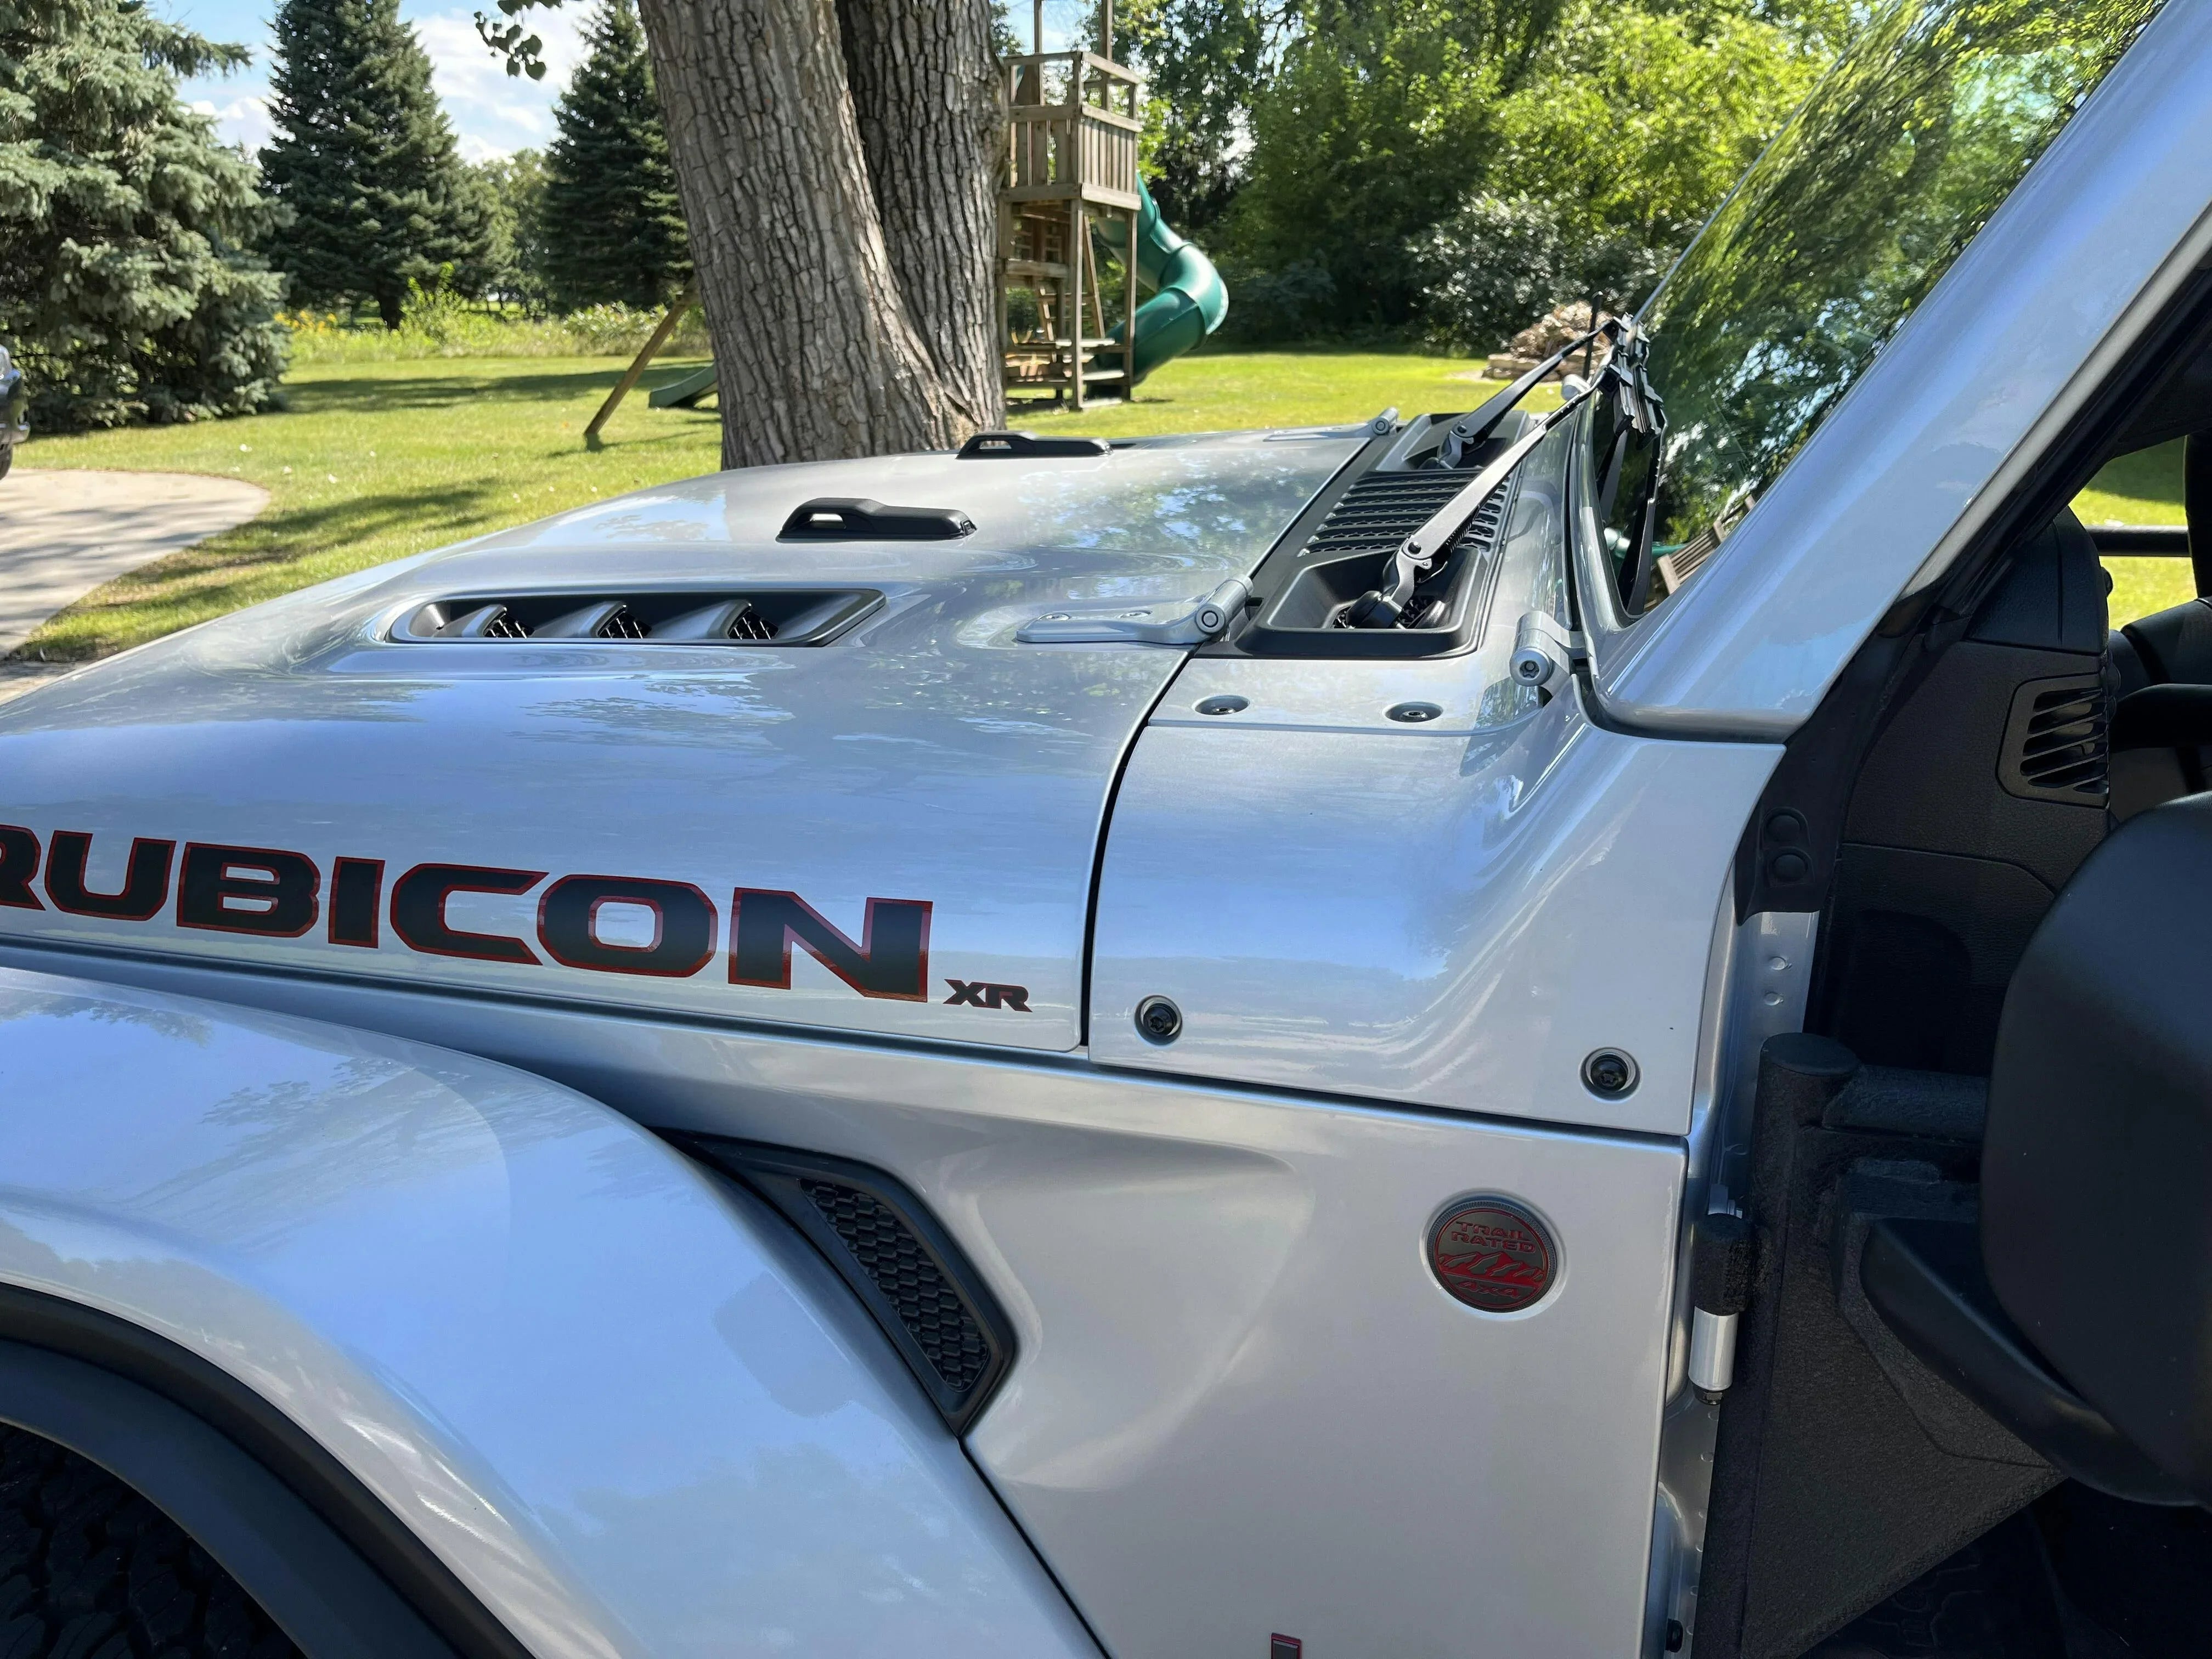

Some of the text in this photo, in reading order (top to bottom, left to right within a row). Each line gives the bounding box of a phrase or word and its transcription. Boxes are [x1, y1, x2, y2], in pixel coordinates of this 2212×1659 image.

[943, 979, 1032, 1012] XR
[1452, 1231, 1536, 1253] RATED
[1456, 1221, 1531, 1241] TRAIL
